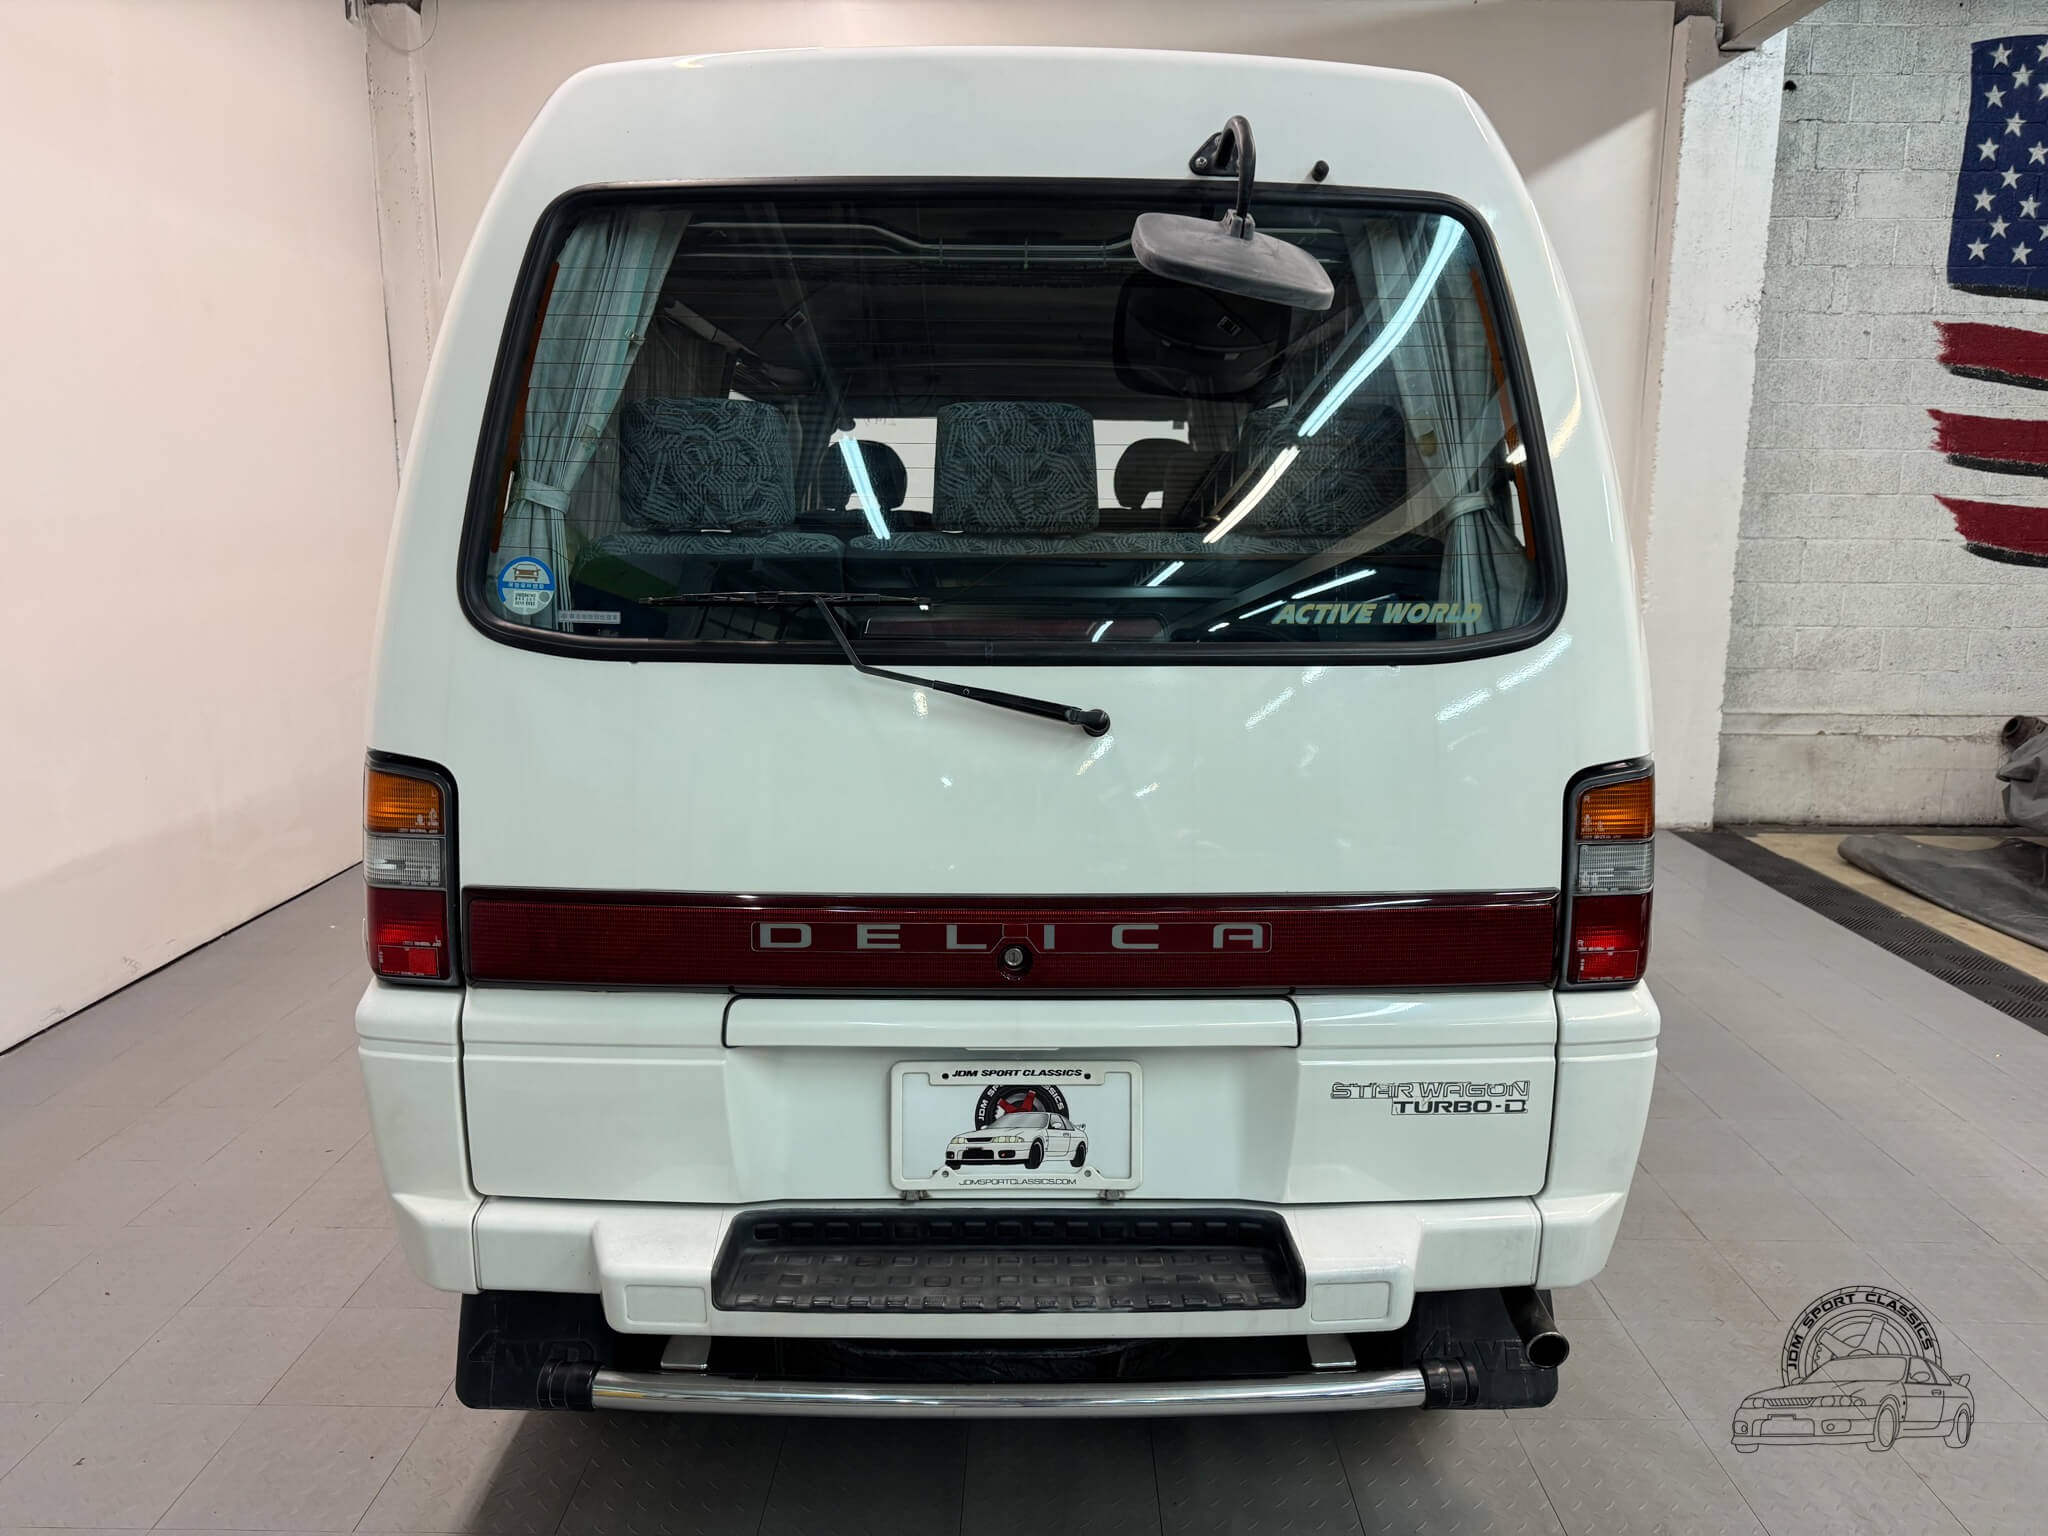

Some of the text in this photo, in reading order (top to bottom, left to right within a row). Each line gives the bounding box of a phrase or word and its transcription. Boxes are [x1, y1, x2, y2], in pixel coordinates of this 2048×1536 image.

[1271, 602, 1484, 625] ACTIVE WORLD
[759, 923, 1265, 951] DELICA
[951, 1068, 1083, 1078] JDM SPORT CLASSICS
[977, 1099, 989, 1122] JDM
[1393, 1099, 1528, 1114] TURBO-D
[959, 1178, 1077, 1186] JDMSPORTCLASSICS.COM
